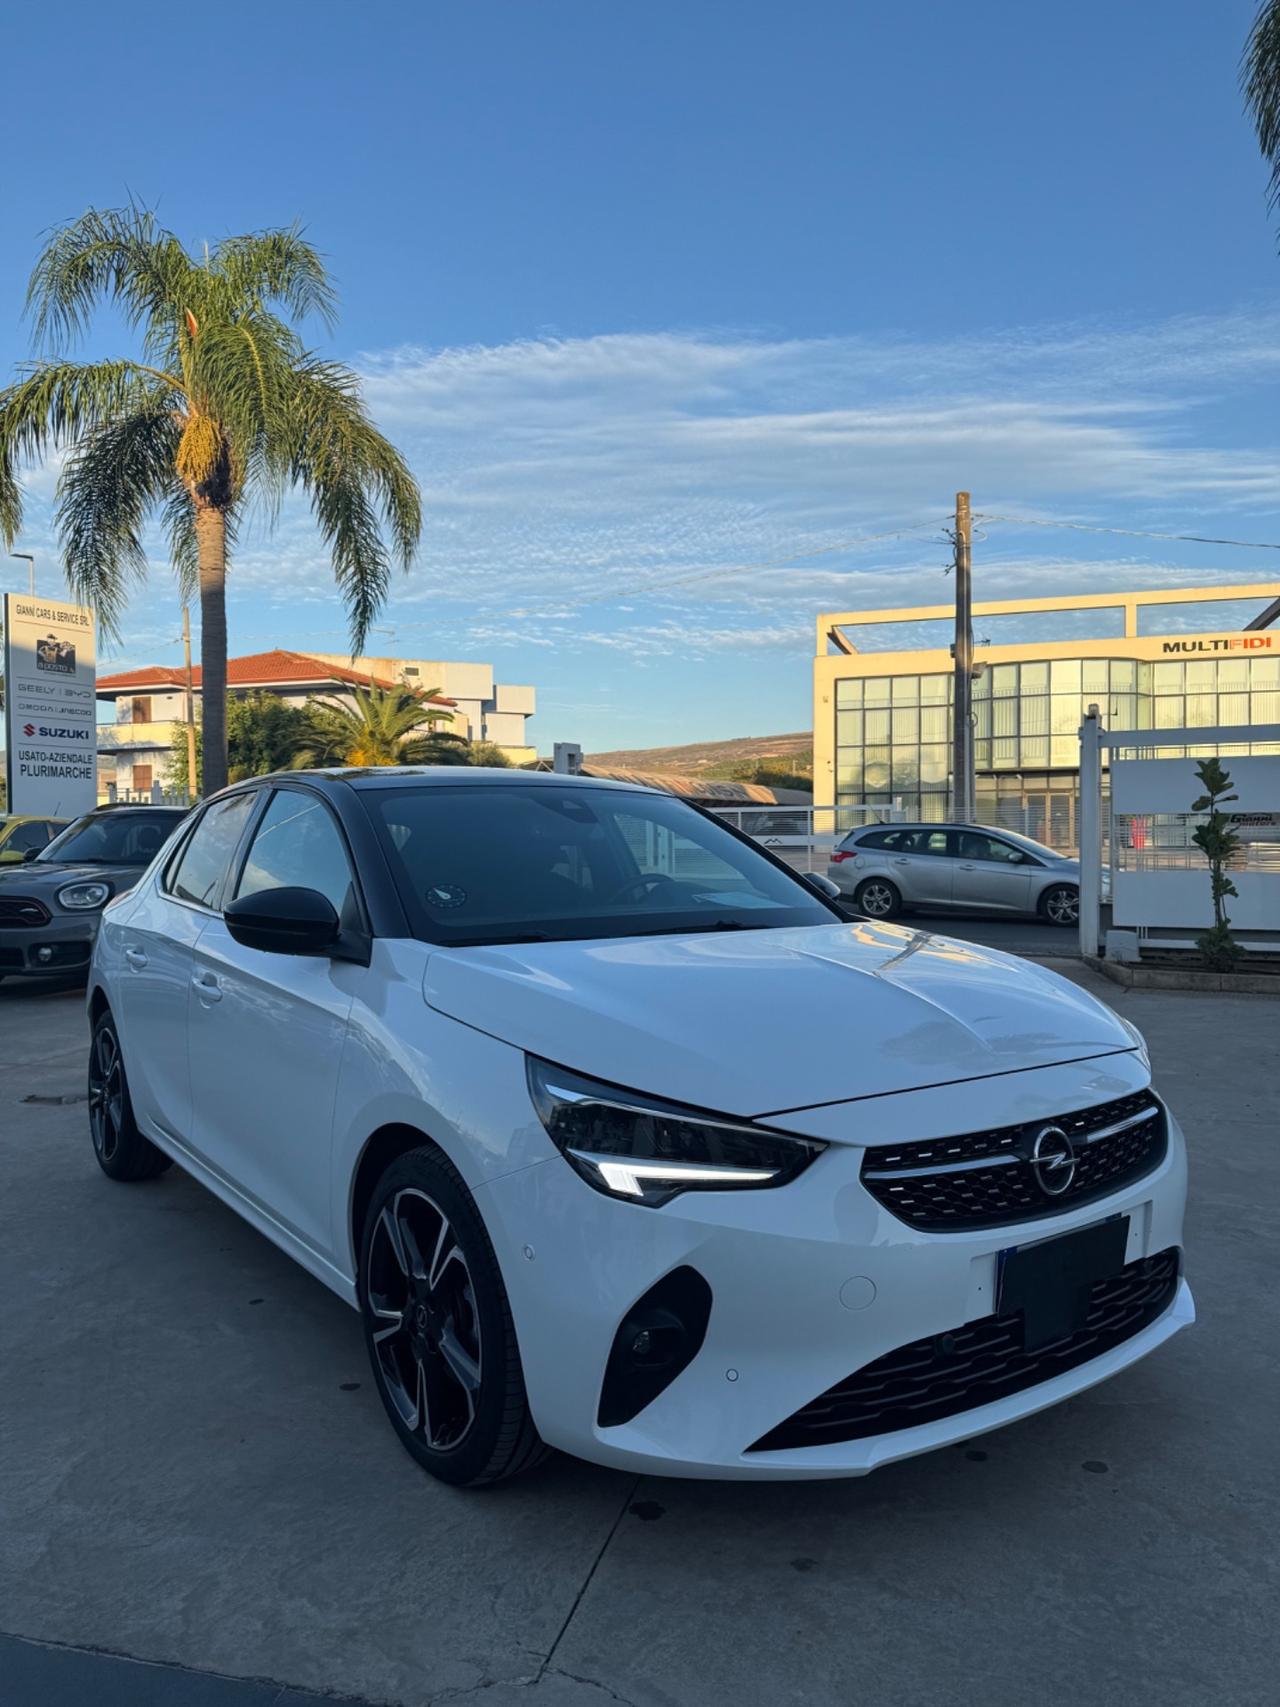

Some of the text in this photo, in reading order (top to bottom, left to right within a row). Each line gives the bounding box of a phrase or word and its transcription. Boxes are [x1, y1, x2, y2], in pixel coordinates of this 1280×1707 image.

[36, 607, 51, 620] CARS
[52, 611, 56, 621] &
[57, 612, 79, 624] SERVICE
[80, 615, 89, 626] SRL
[1163, 637, 1272, 653] MULTIFIDI
[18, 683, 92, 698] GEELY BYD
[18, 703, 54, 712] OMODA
[39, 726, 89, 740] SUZUKI
[19, 750, 93, 764] USATO-AZIENDALE
[20, 764, 92, 779] PLURIMARCHE
